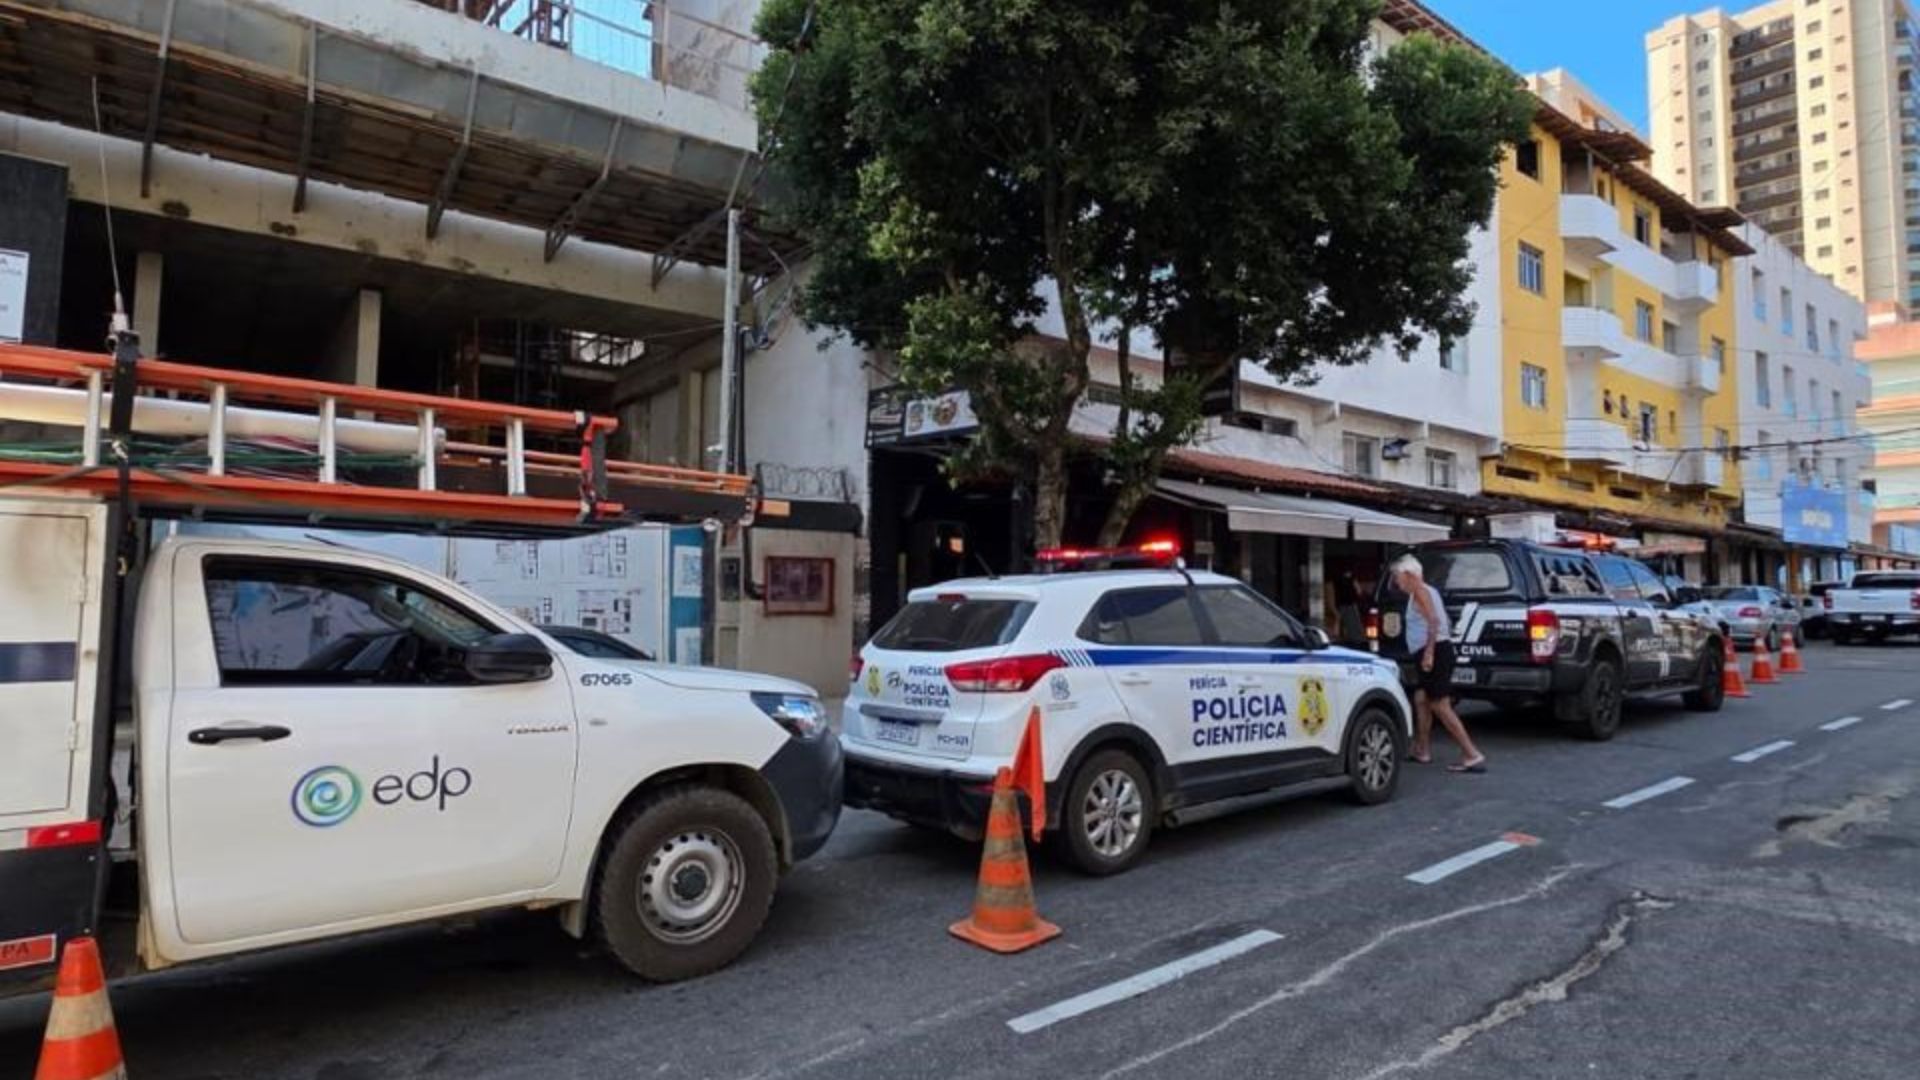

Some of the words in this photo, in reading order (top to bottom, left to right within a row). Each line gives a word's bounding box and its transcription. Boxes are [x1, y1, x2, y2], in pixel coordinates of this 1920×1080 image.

[1461, 645, 1496, 656] CIVIL
[580, 673, 632, 687] 67065
[1193, 690, 1287, 722] POLÍCIA
[1193, 718, 1287, 747] CIENTÍFICA
[373, 754, 471, 811] edp
